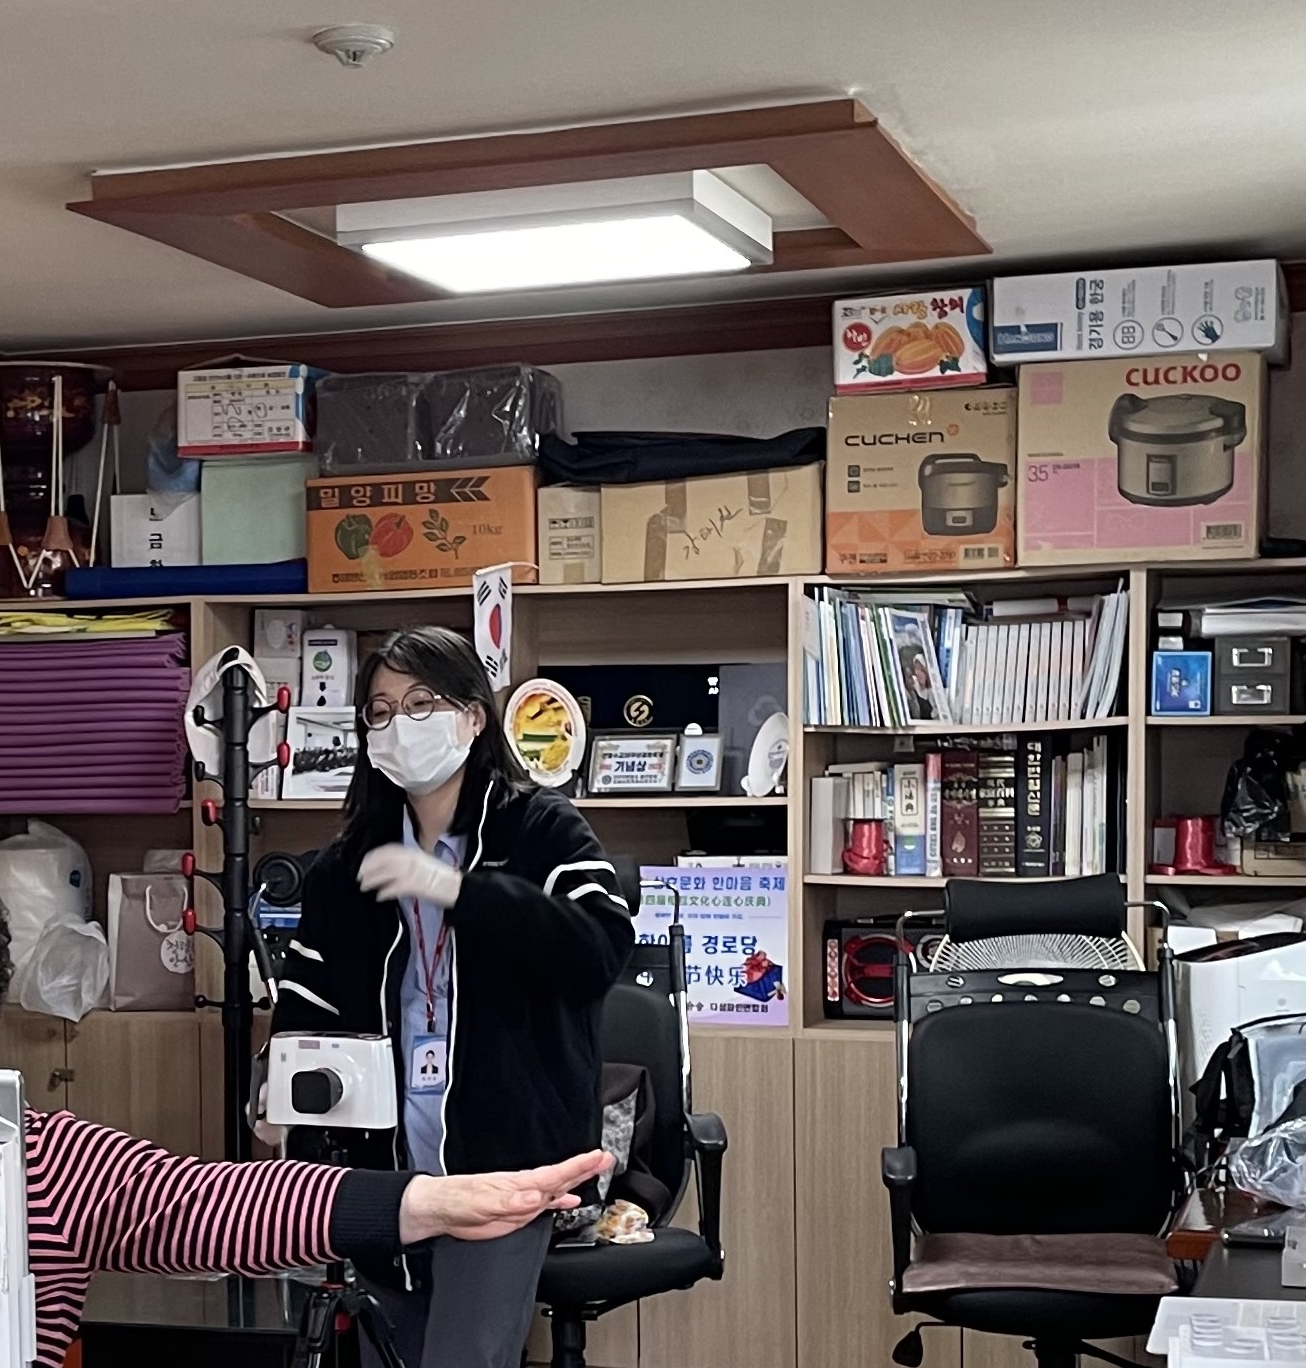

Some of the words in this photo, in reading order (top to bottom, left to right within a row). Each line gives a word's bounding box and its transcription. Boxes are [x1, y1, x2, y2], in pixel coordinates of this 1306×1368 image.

[1125, 363, 1241, 387] CUCKOO
[845, 431, 944, 446] CUCHEN
[1027, 465, 1048, 482] 35
[472, 523, 503, 536] 10kg
[614, 761, 647, 772] 기념상
[759, 876, 785, 891] 축제
[701, 935, 758, 956] 경로당
